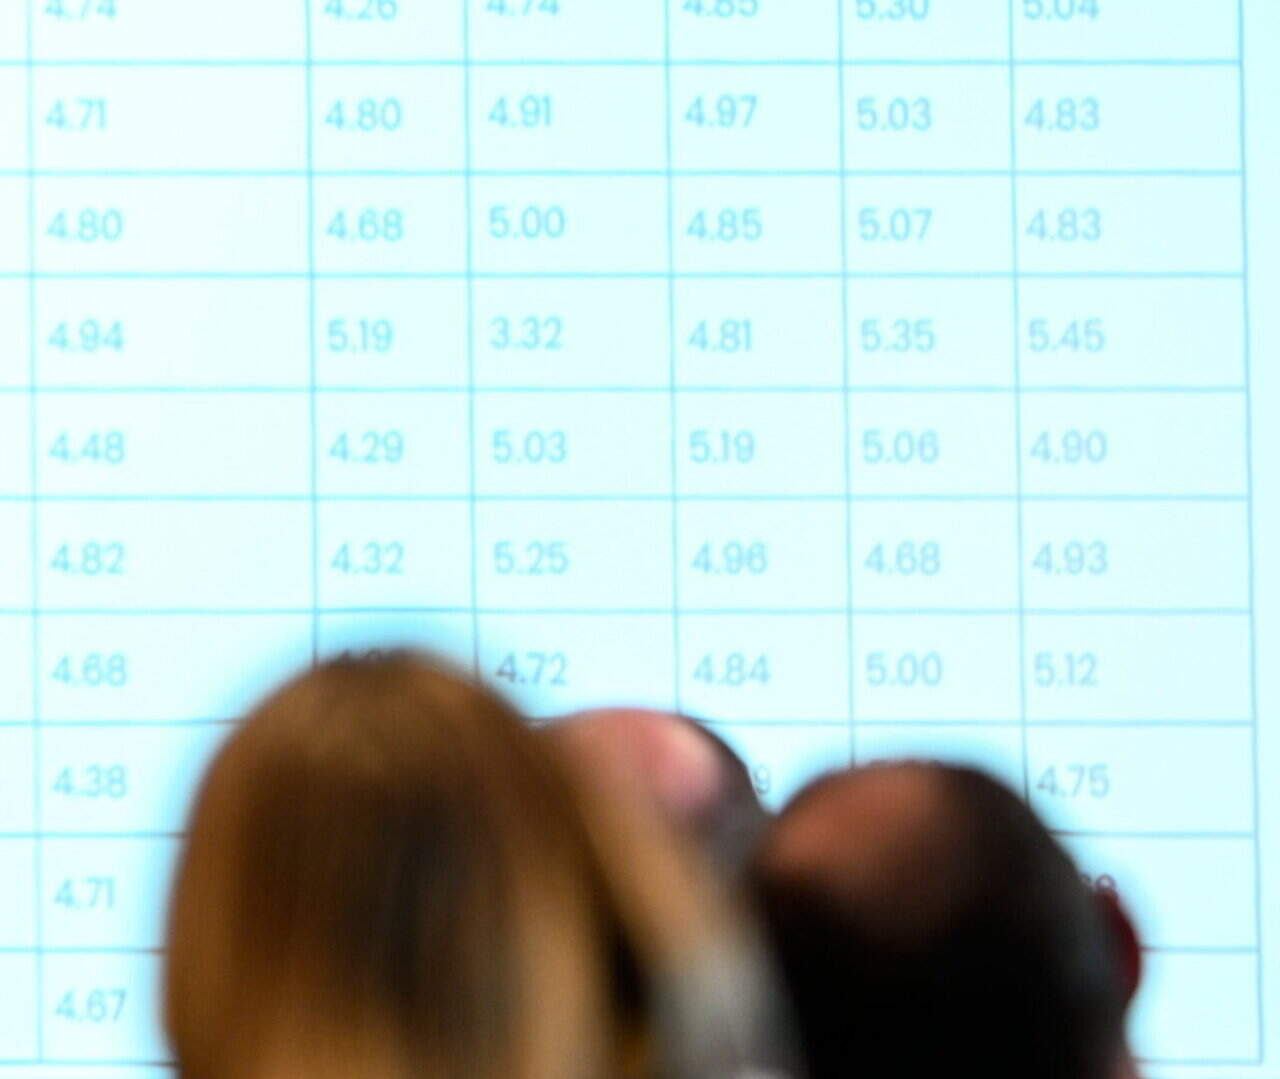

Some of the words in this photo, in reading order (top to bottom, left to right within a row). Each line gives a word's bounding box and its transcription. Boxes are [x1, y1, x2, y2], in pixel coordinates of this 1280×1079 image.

[48, 318, 125, 352] 4.94
[327, 317, 395, 353] 5.19
[490, 315, 564, 350] 3.32
[860, 318, 936, 352] 5.35
[1029, 317, 1107, 352] 5.45
[49, 541, 126, 576] 4.82
[330, 541, 404, 576] 4.32
[493, 540, 571, 576] 5.25
[1033, 541, 1110, 577] 4.93
